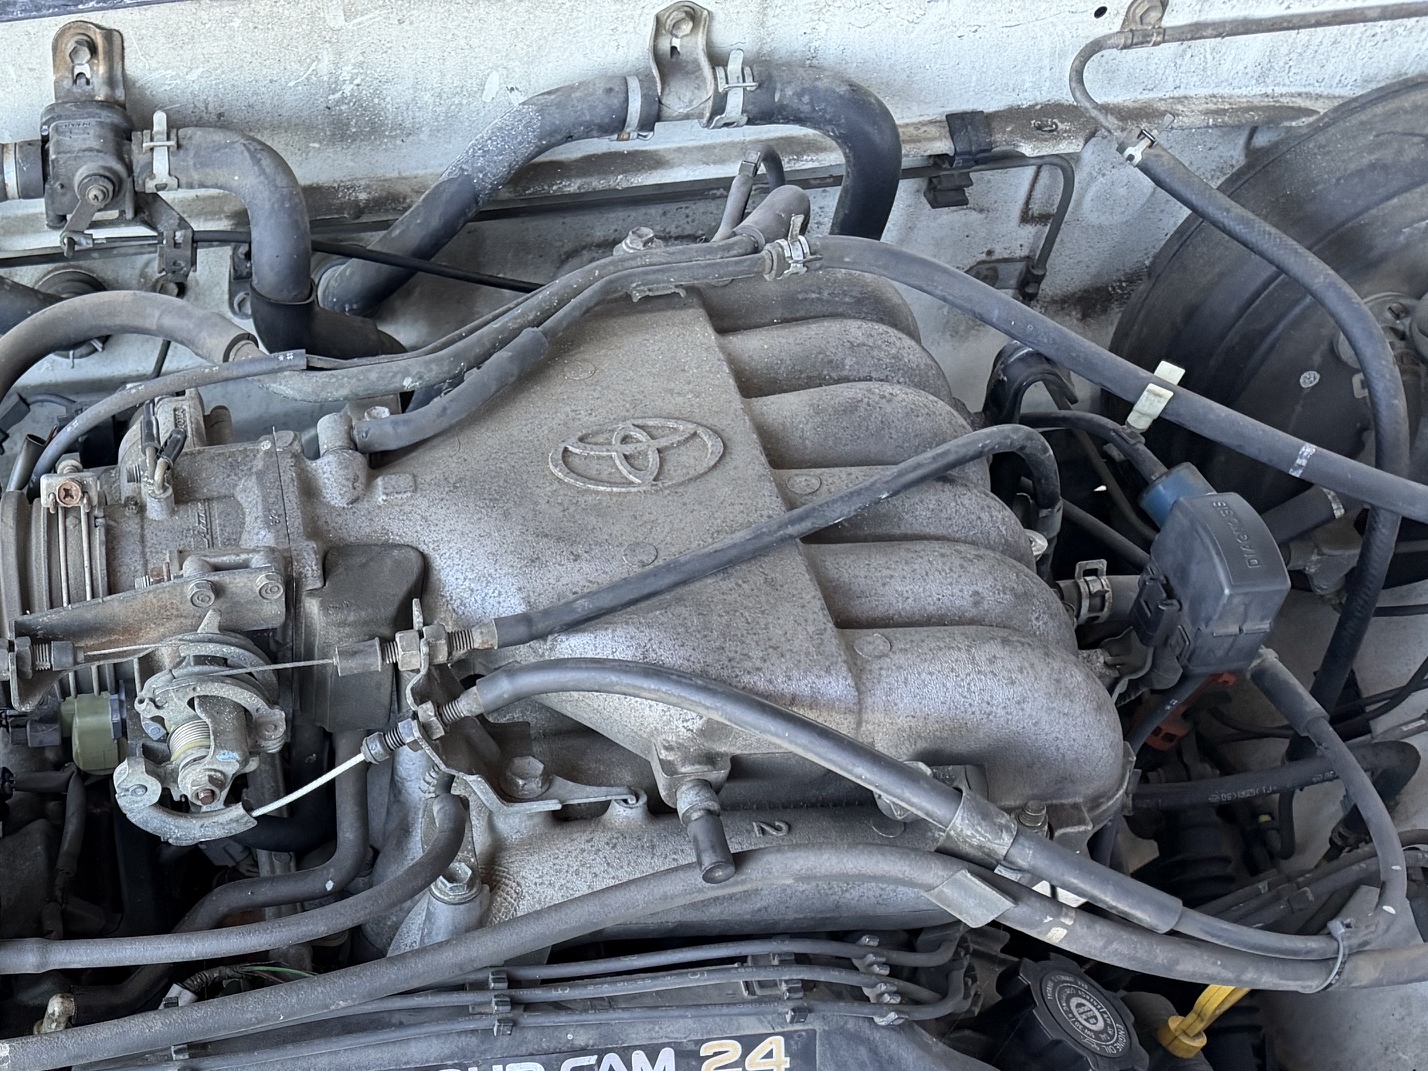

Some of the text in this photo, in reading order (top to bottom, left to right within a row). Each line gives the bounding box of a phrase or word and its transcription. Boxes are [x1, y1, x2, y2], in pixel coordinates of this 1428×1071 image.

[1212, 501, 1261, 569] DIAGNOSIS
[1102, 1045, 1117, 1054] OIL
[1115, 1023, 1127, 1052] ENGINE
